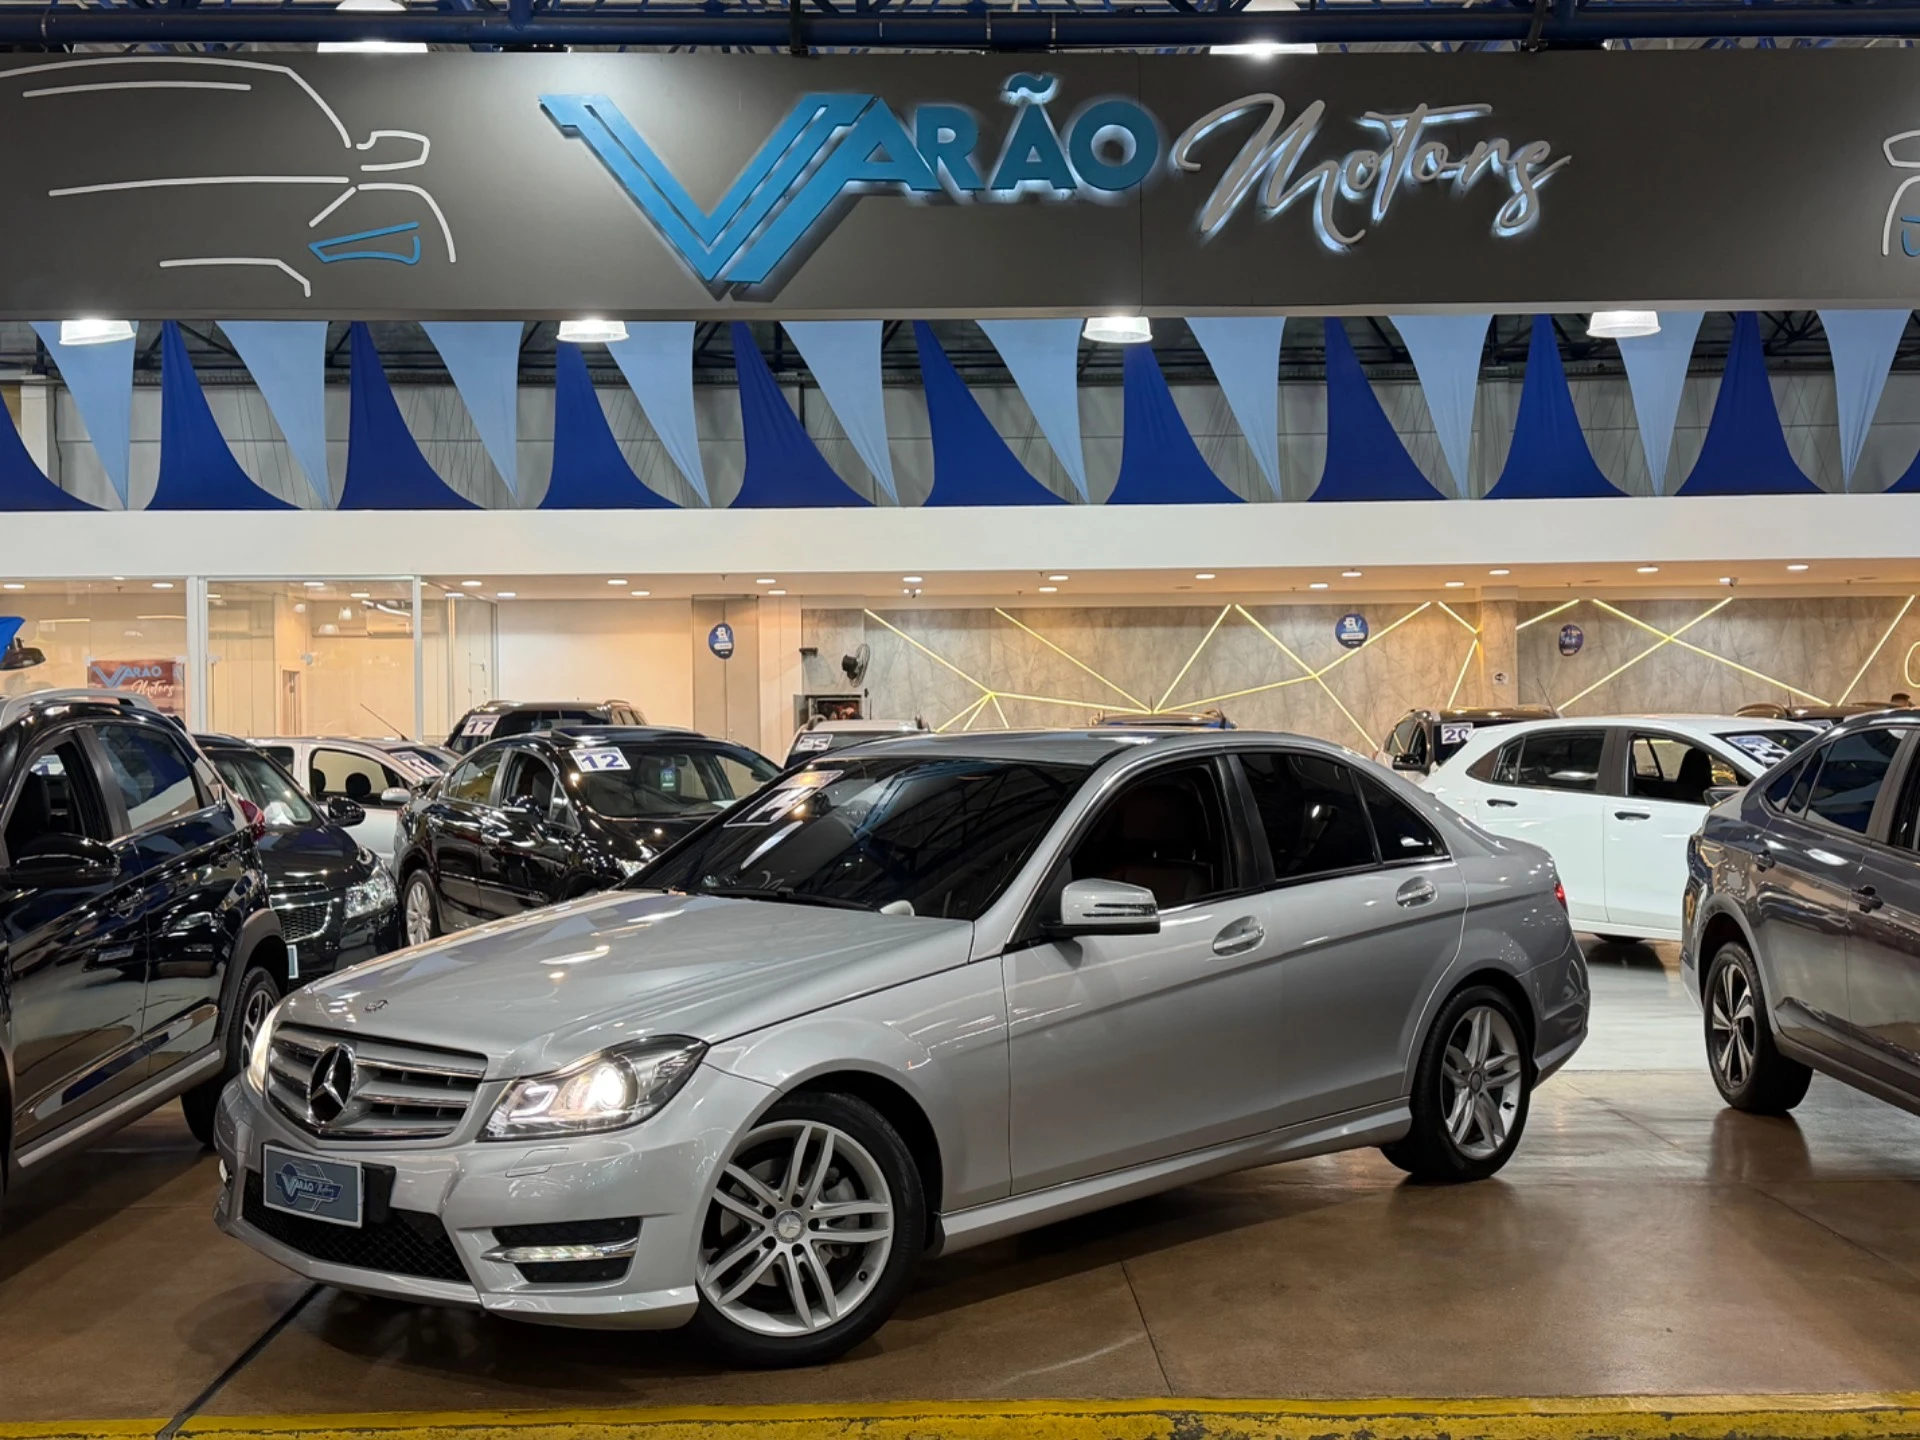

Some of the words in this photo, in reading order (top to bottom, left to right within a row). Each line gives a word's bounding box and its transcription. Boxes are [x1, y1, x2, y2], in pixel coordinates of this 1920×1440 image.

[540, 73, 1159, 284] VARÃO
[1172, 92, 1573, 248] Motors
[468, 721, 495, 734] 17
[1444, 728, 1469, 741] 20
[581, 753, 623, 769] 12
